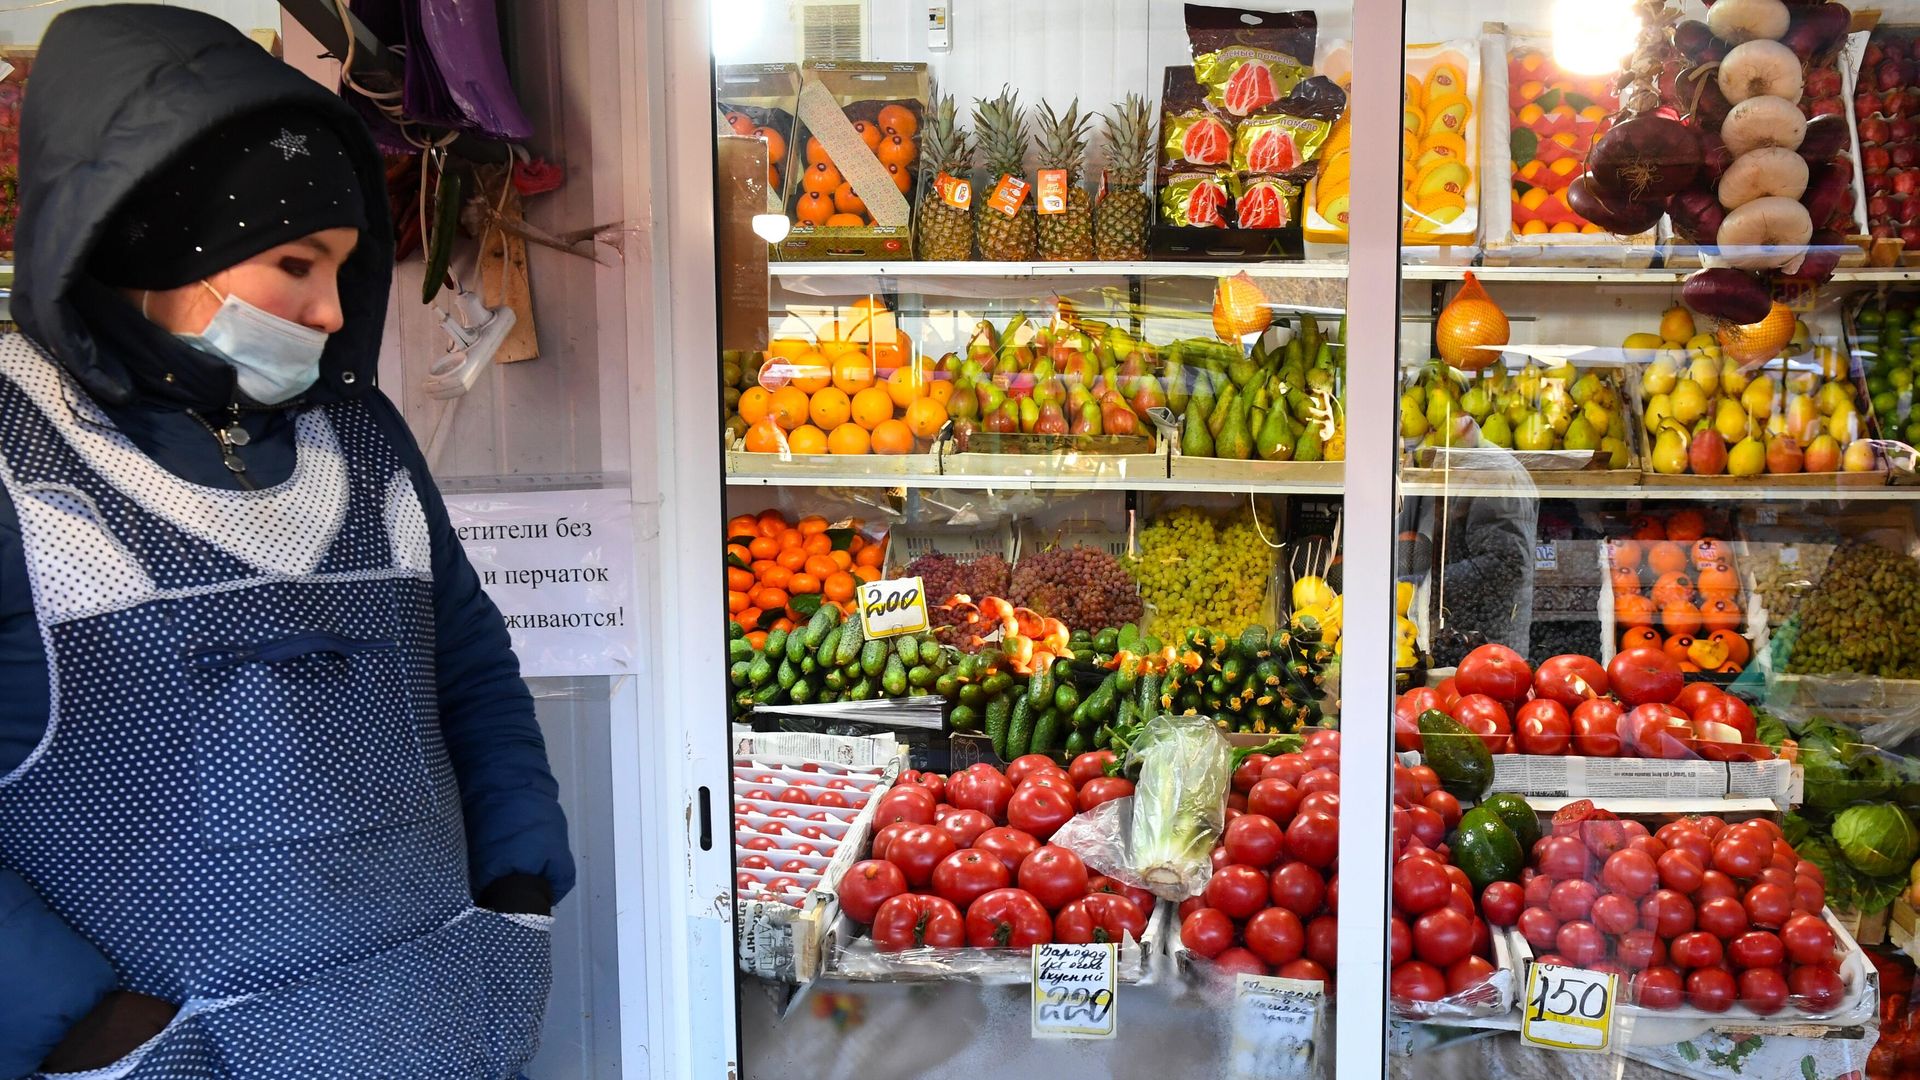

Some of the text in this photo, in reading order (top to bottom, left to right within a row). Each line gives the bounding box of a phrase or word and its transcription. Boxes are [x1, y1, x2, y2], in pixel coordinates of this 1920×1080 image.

[456, 517, 592, 541] етители без
[484, 566, 609, 589] и перчаток
[865, 588, 919, 618] 200
[504, 606, 624, 629] живаются!
[1529, 976, 1608, 1022] 150
